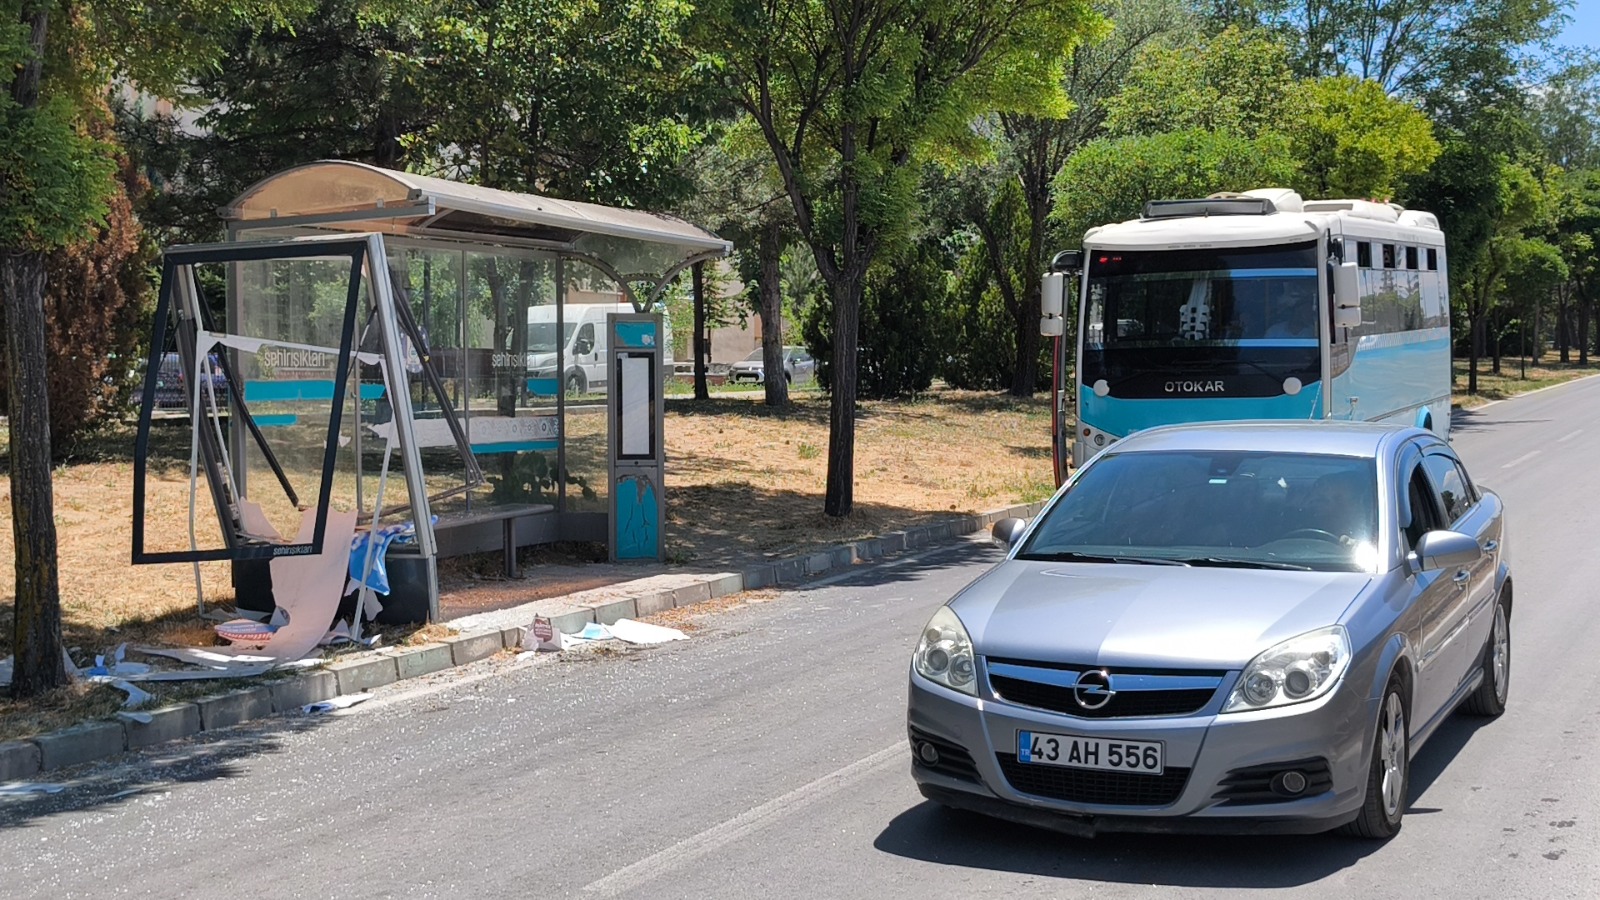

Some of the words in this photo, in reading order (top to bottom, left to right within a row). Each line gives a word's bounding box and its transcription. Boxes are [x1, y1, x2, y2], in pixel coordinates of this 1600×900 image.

[1164, 381, 1225, 392] OTOKAR
[1031, 737, 1060, 761] 43
[1068, 740, 1100, 765] AH
[1107, 743, 1158, 770] 556
